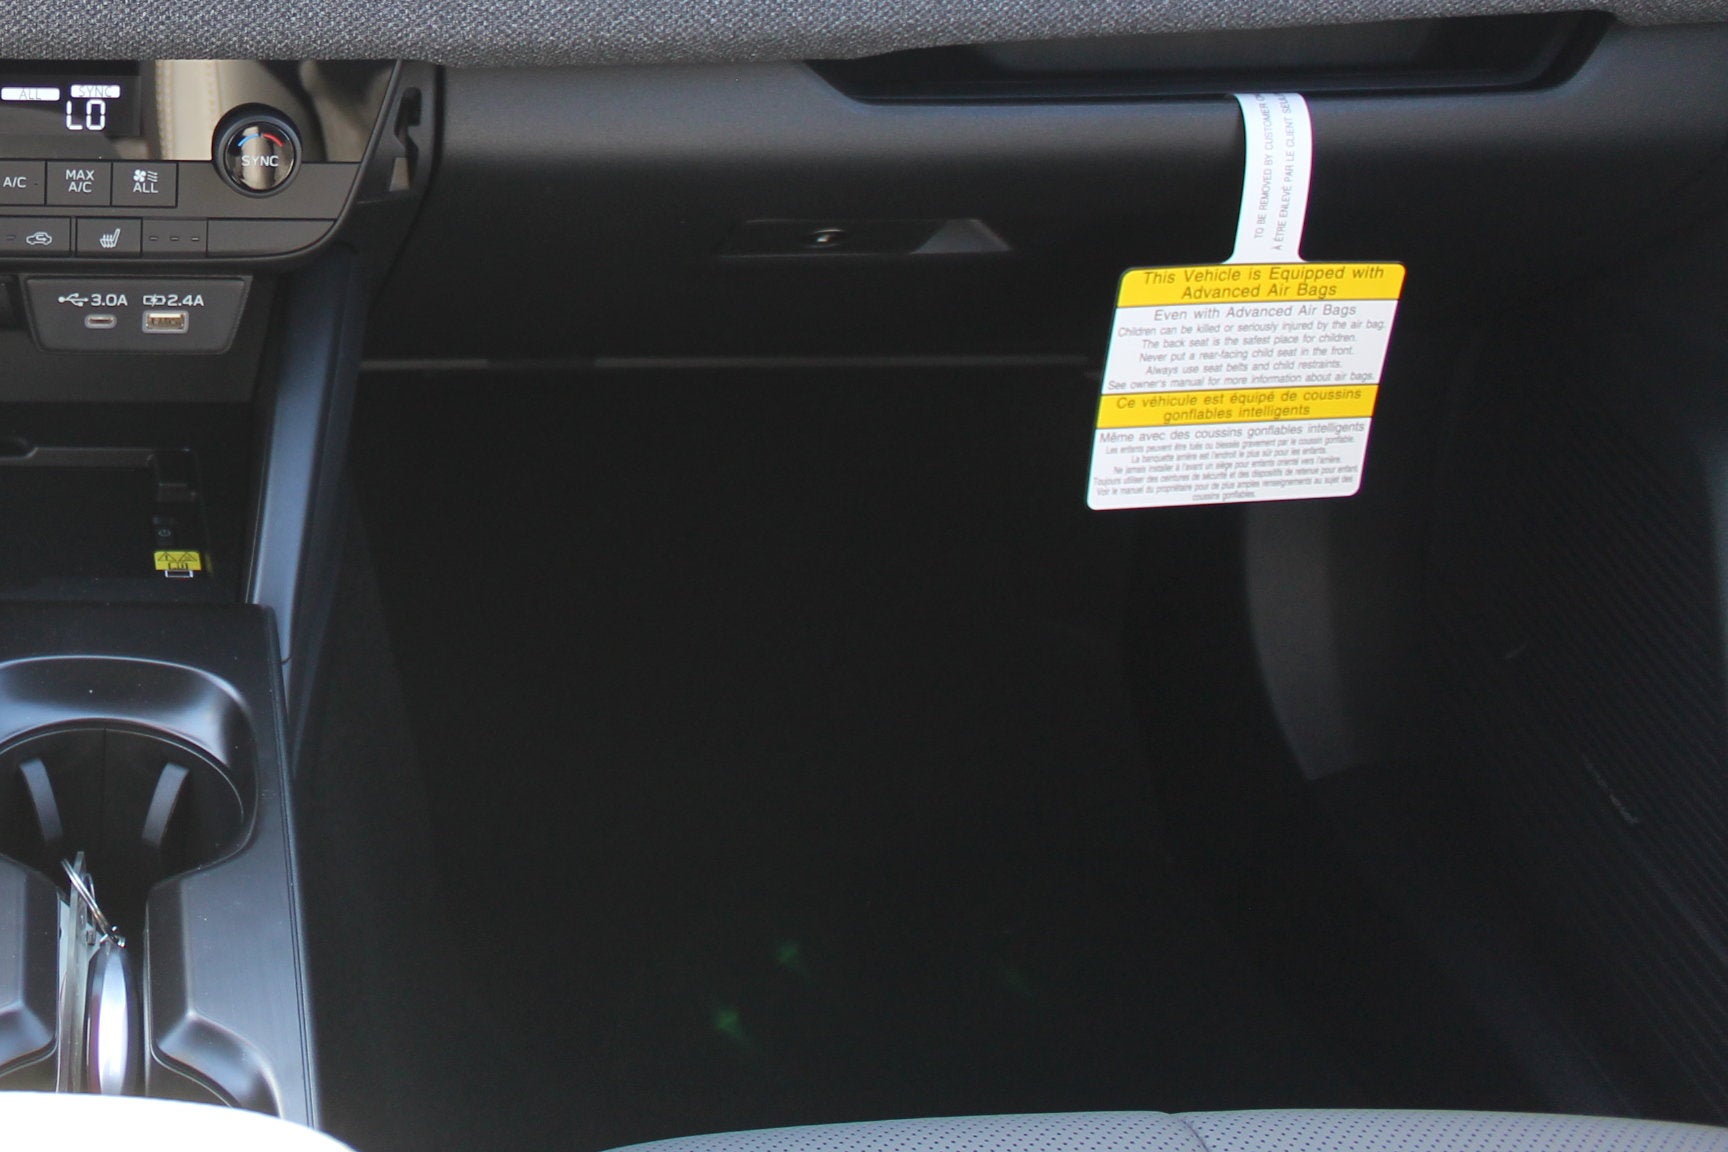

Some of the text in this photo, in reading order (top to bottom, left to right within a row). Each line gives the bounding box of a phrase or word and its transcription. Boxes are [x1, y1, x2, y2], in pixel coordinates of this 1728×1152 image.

[18, 88, 43, 100] ALL
[78, 85, 112, 98] SYNC
[66, 99, 107, 131] LO
[241, 155, 280, 167] SYNC
[65, 169, 95, 181] MAX
[3, 177, 27, 188] A/C
[68, 181, 93, 194] A/C
[133, 182, 159, 194] ALL
[1142, 266, 1384, 284] This Vehicle is Equipped with
[1181, 282, 1337, 299] Advanced Air Bags
[90, 294, 128, 307] 3.0A
[167, 294, 205, 307] 2.4A
[1154, 303, 1356, 320] Even with Advanced Air Bags
[1116, 397, 1135, 408] Ce
[1142, 394, 1197, 407] véhicule
[1203, 394, 1223, 404] est
[1280, 391, 1297, 401] de
[1303, 389, 1361, 400] coussins
[1163, 404, 1310, 423] gonflables intelligents
[1170, 430, 1190, 439] des
[1194, 427, 1241, 438] coussins
[1247, 424, 1303, 438] gonflables
[1307, 422, 1365, 435] intelligents
